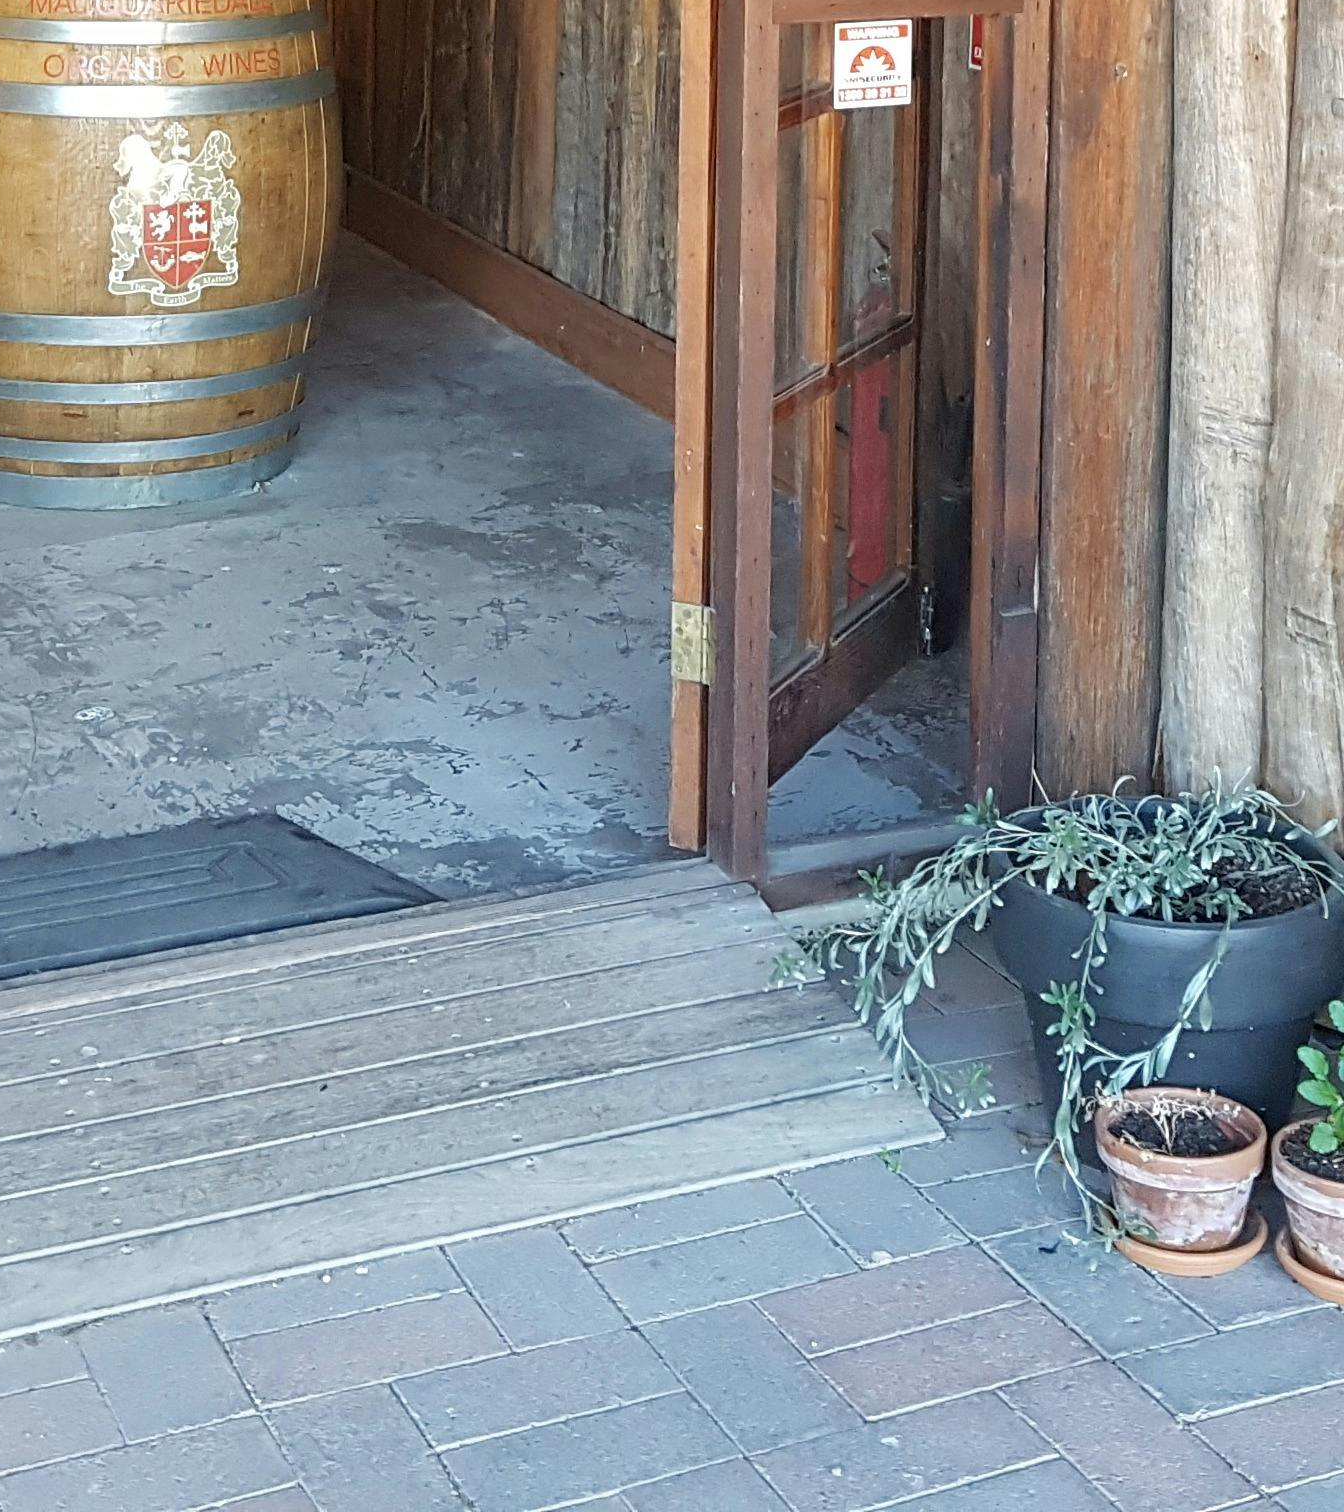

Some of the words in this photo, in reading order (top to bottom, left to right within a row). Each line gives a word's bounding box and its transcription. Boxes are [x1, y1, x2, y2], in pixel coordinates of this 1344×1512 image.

[845, 25, 900, 41] WARNING
[43, 52, 185, 81] ORGANIC
[201, 47, 281, 79] WINES
